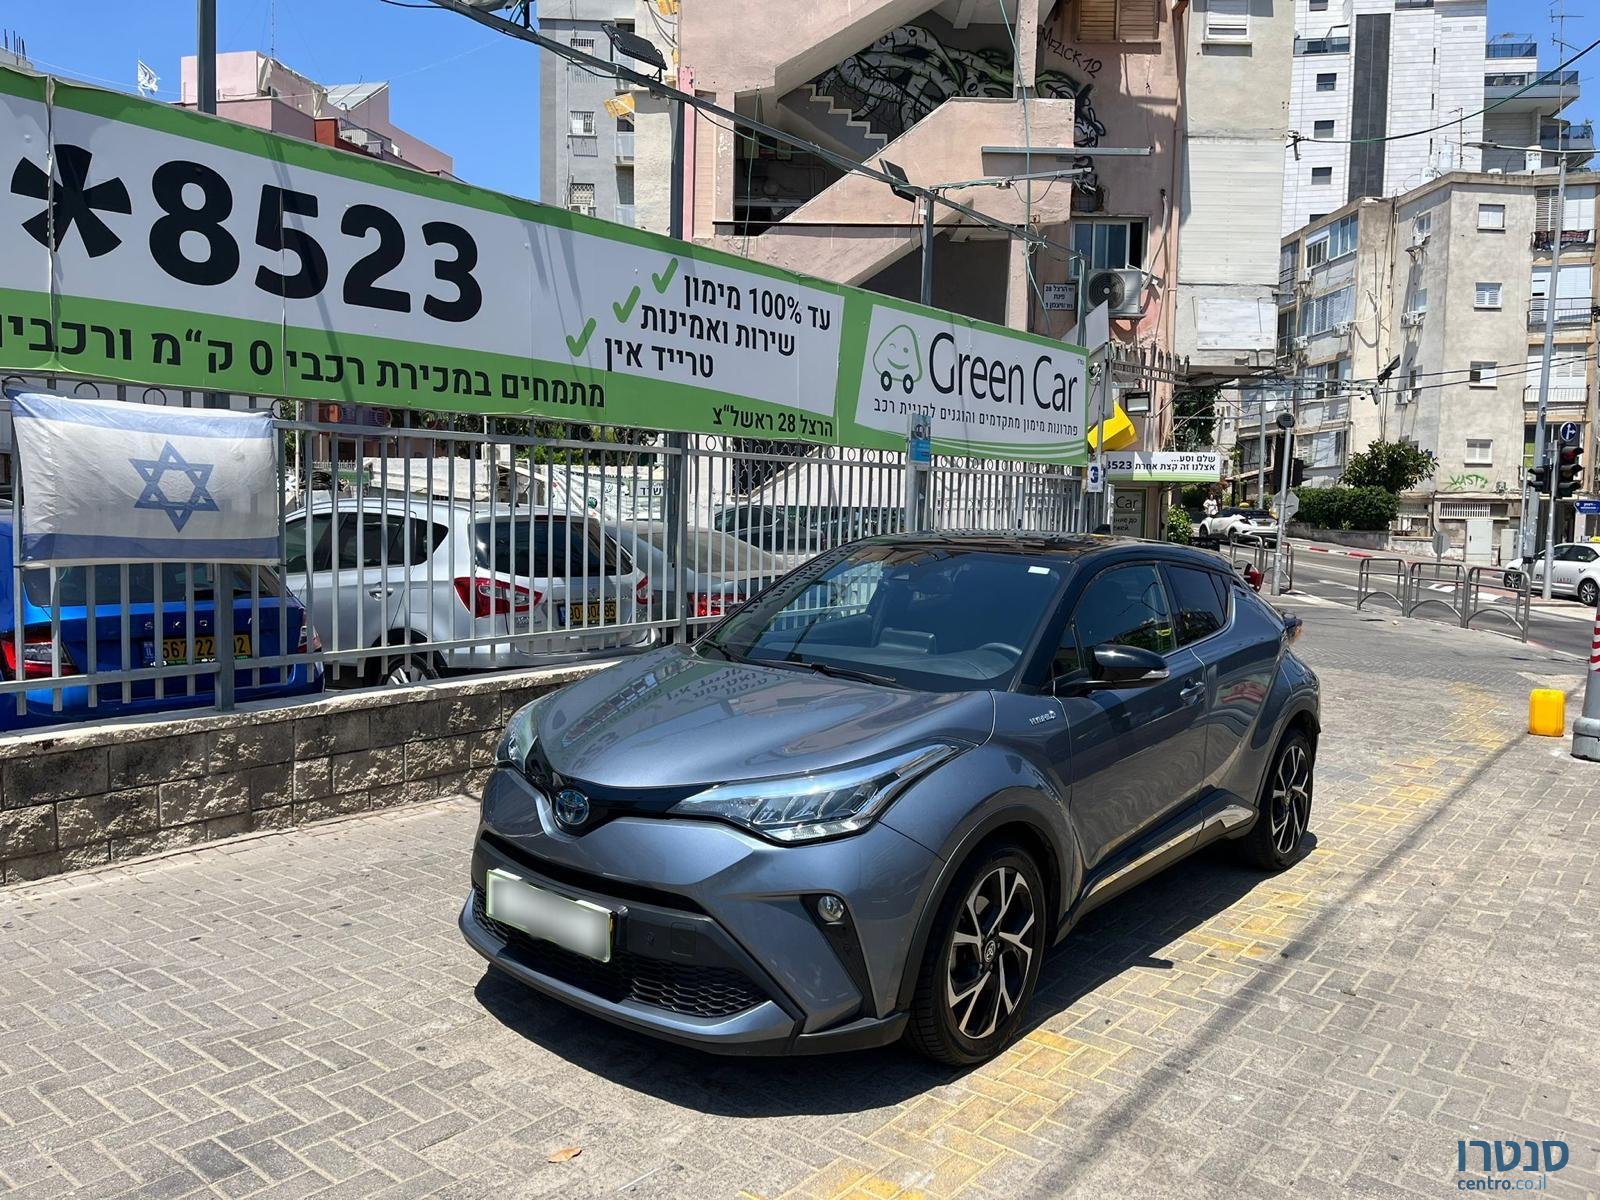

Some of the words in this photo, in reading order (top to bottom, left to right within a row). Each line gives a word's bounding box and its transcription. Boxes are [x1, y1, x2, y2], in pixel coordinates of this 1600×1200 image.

[684, 275, 741, 311] מימון
[749, 288, 802, 324] 100%
[640, 304, 728, 344] ואמינות
[807, 305, 831, 331] עד
[0, 314, 132, 361] ורכבי
[735, 324, 795, 357] שירות
[250, 340, 273, 376] 0
[286, 350, 365, 385] רכבי
[605, 337, 643, 372] אין
[651, 345, 714, 378] טרייד
[376, 359, 492, 397] במכירת
[929, 332, 1024, 406] Green
[1033, 355, 1078, 413] Car
[501, 373, 605, 408] מתמחים
[712, 404, 773, 430] ראשל"צ
[874, 398, 895, 413] רכב
[940, 407, 975, 424] והוגנים
[778, 412, 796, 433] 28
[800, 414, 833, 437] הרצל
[979, 412, 1020, 430] מתקדמים
[1023, 418, 1045, 433] מימון
[1047, 422, 1078, 436] פתרונות
[1160, 463, 1178, 472] קצת
[1180, 463, 1189, 471] זה
[1191, 463, 1216, 471] אצלנו
[1196, 454, 1216, 463] שלם
[1116, 496, 1138, 509] Car
